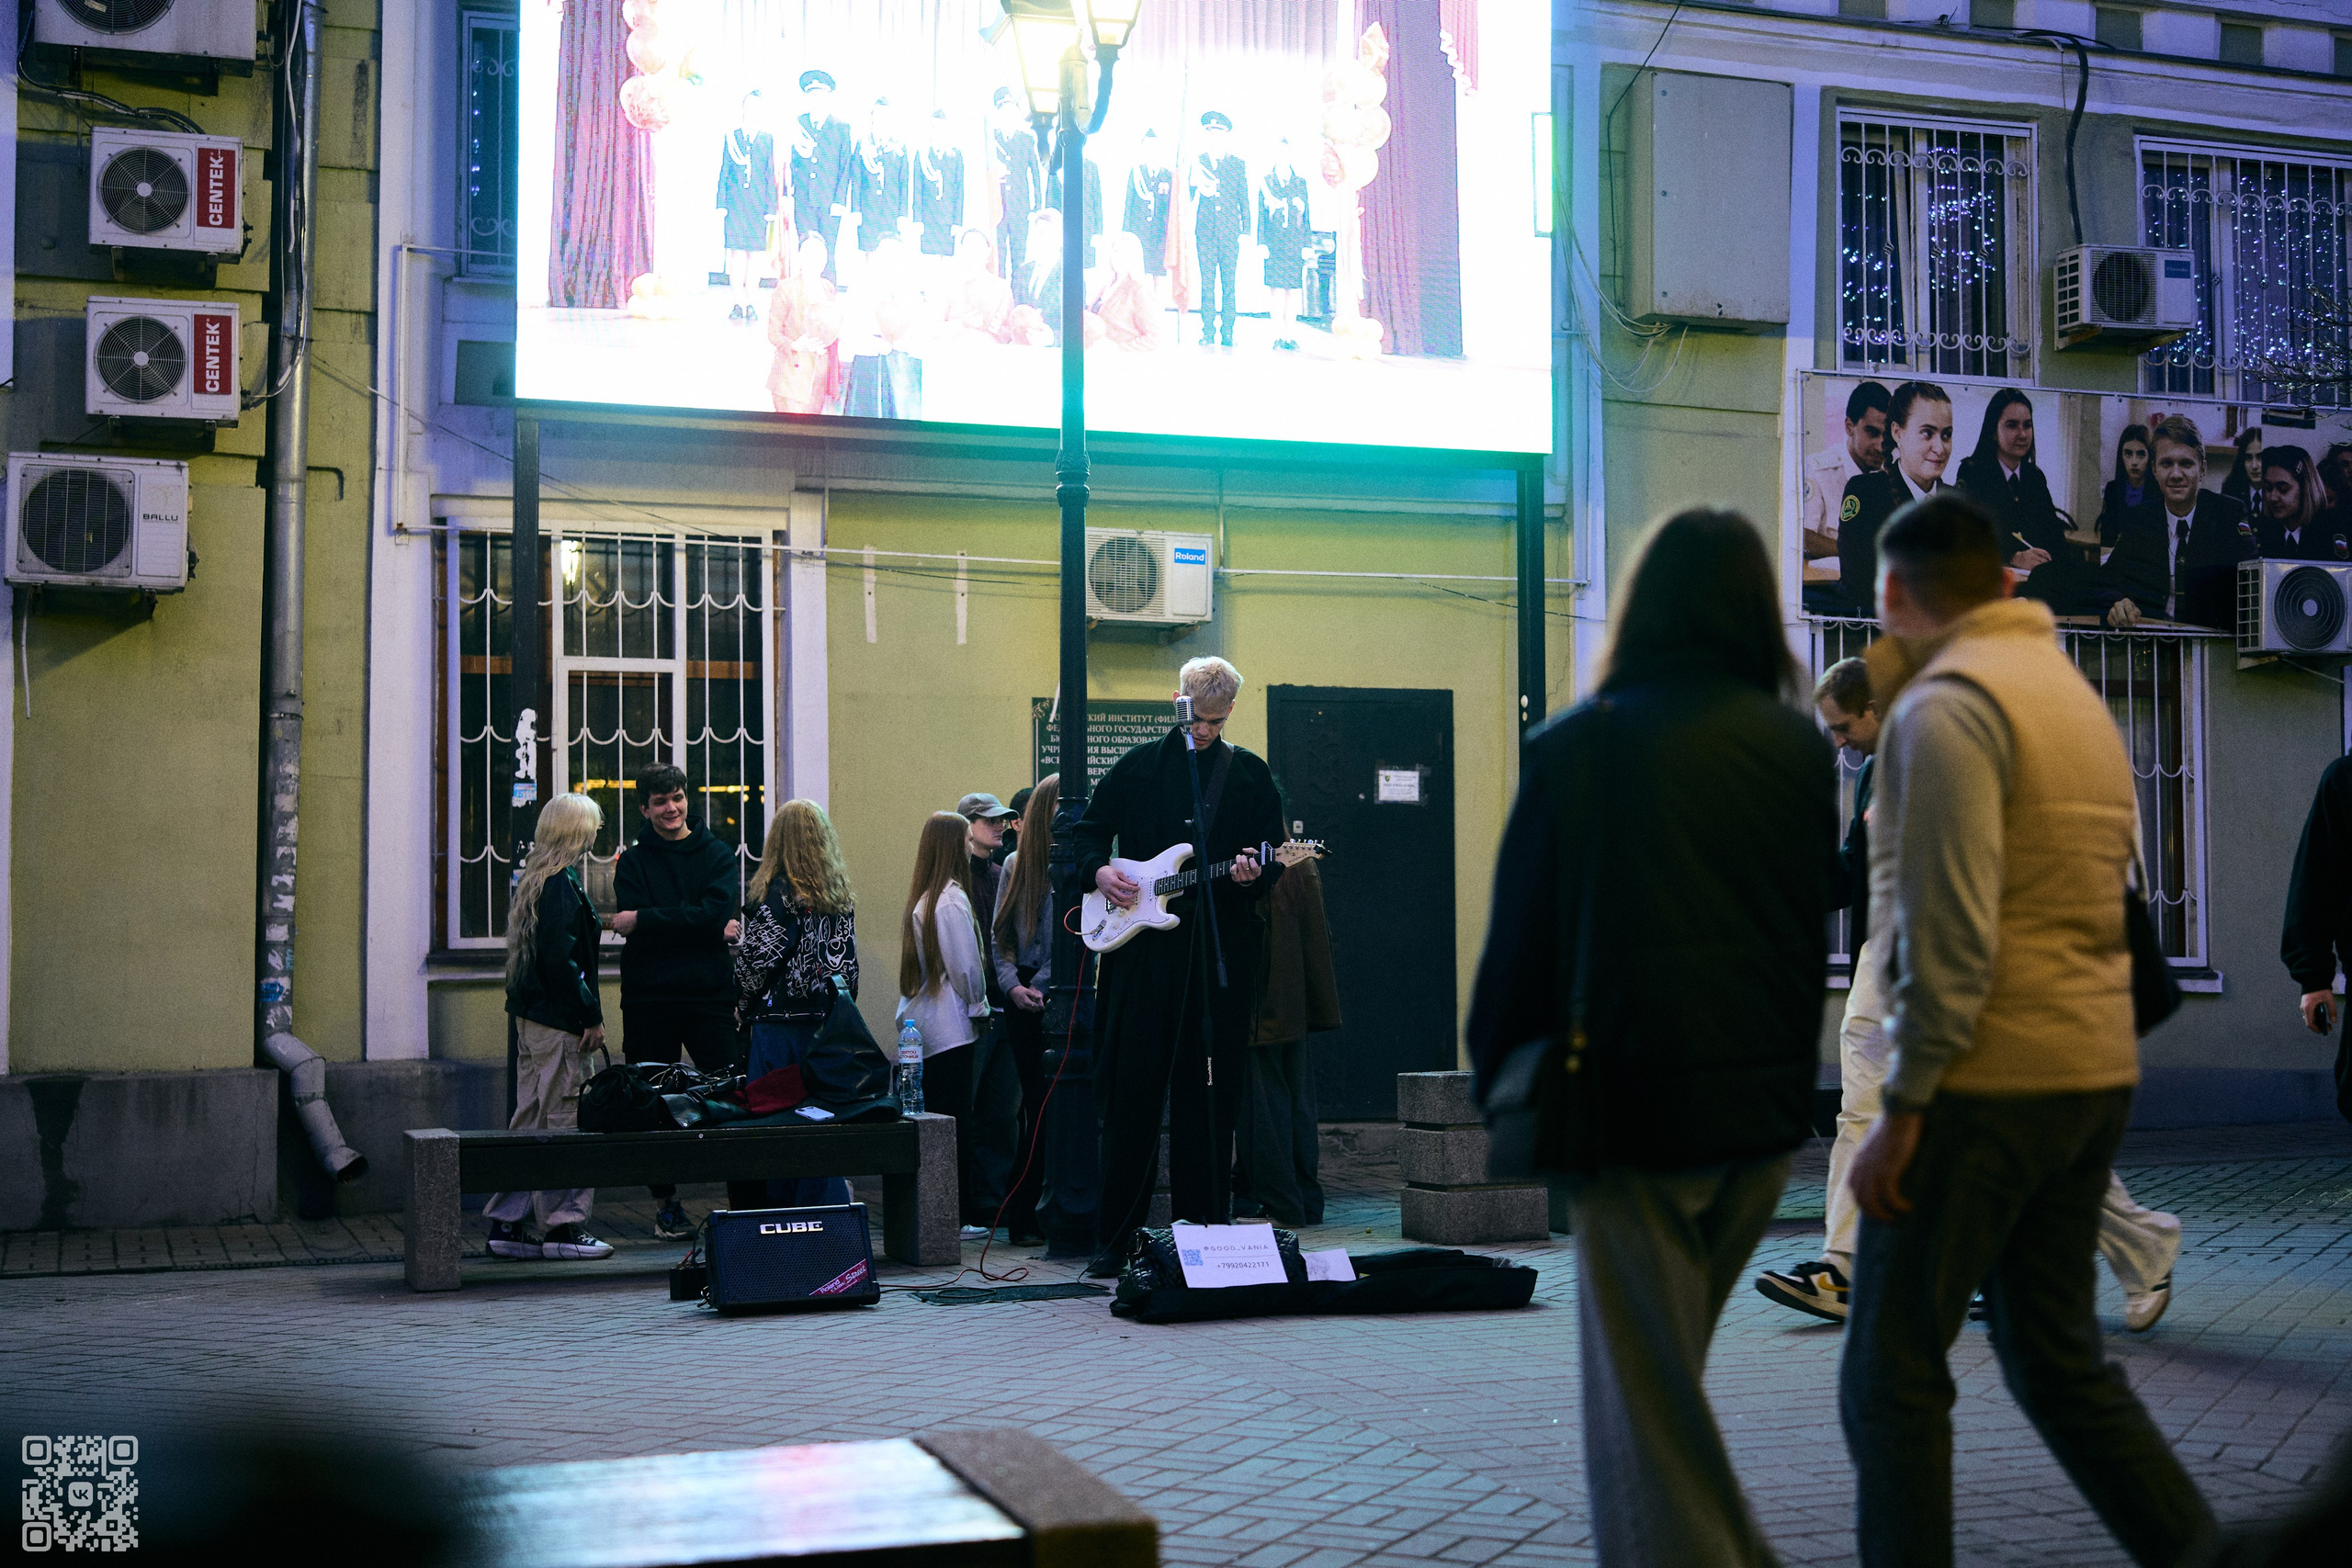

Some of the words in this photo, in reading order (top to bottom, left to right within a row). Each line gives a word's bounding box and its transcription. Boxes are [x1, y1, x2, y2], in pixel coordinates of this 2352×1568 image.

[209, 156, 223, 226] CENTEK
[205, 322, 220, 392] CENTEK
[1175, 551, 1204, 561] Roland
[1155, 716, 1176, 724] (ФИЛ
[759, 1221, 824, 1235] CUBE
[845, 1265, 867, 1284] Street
